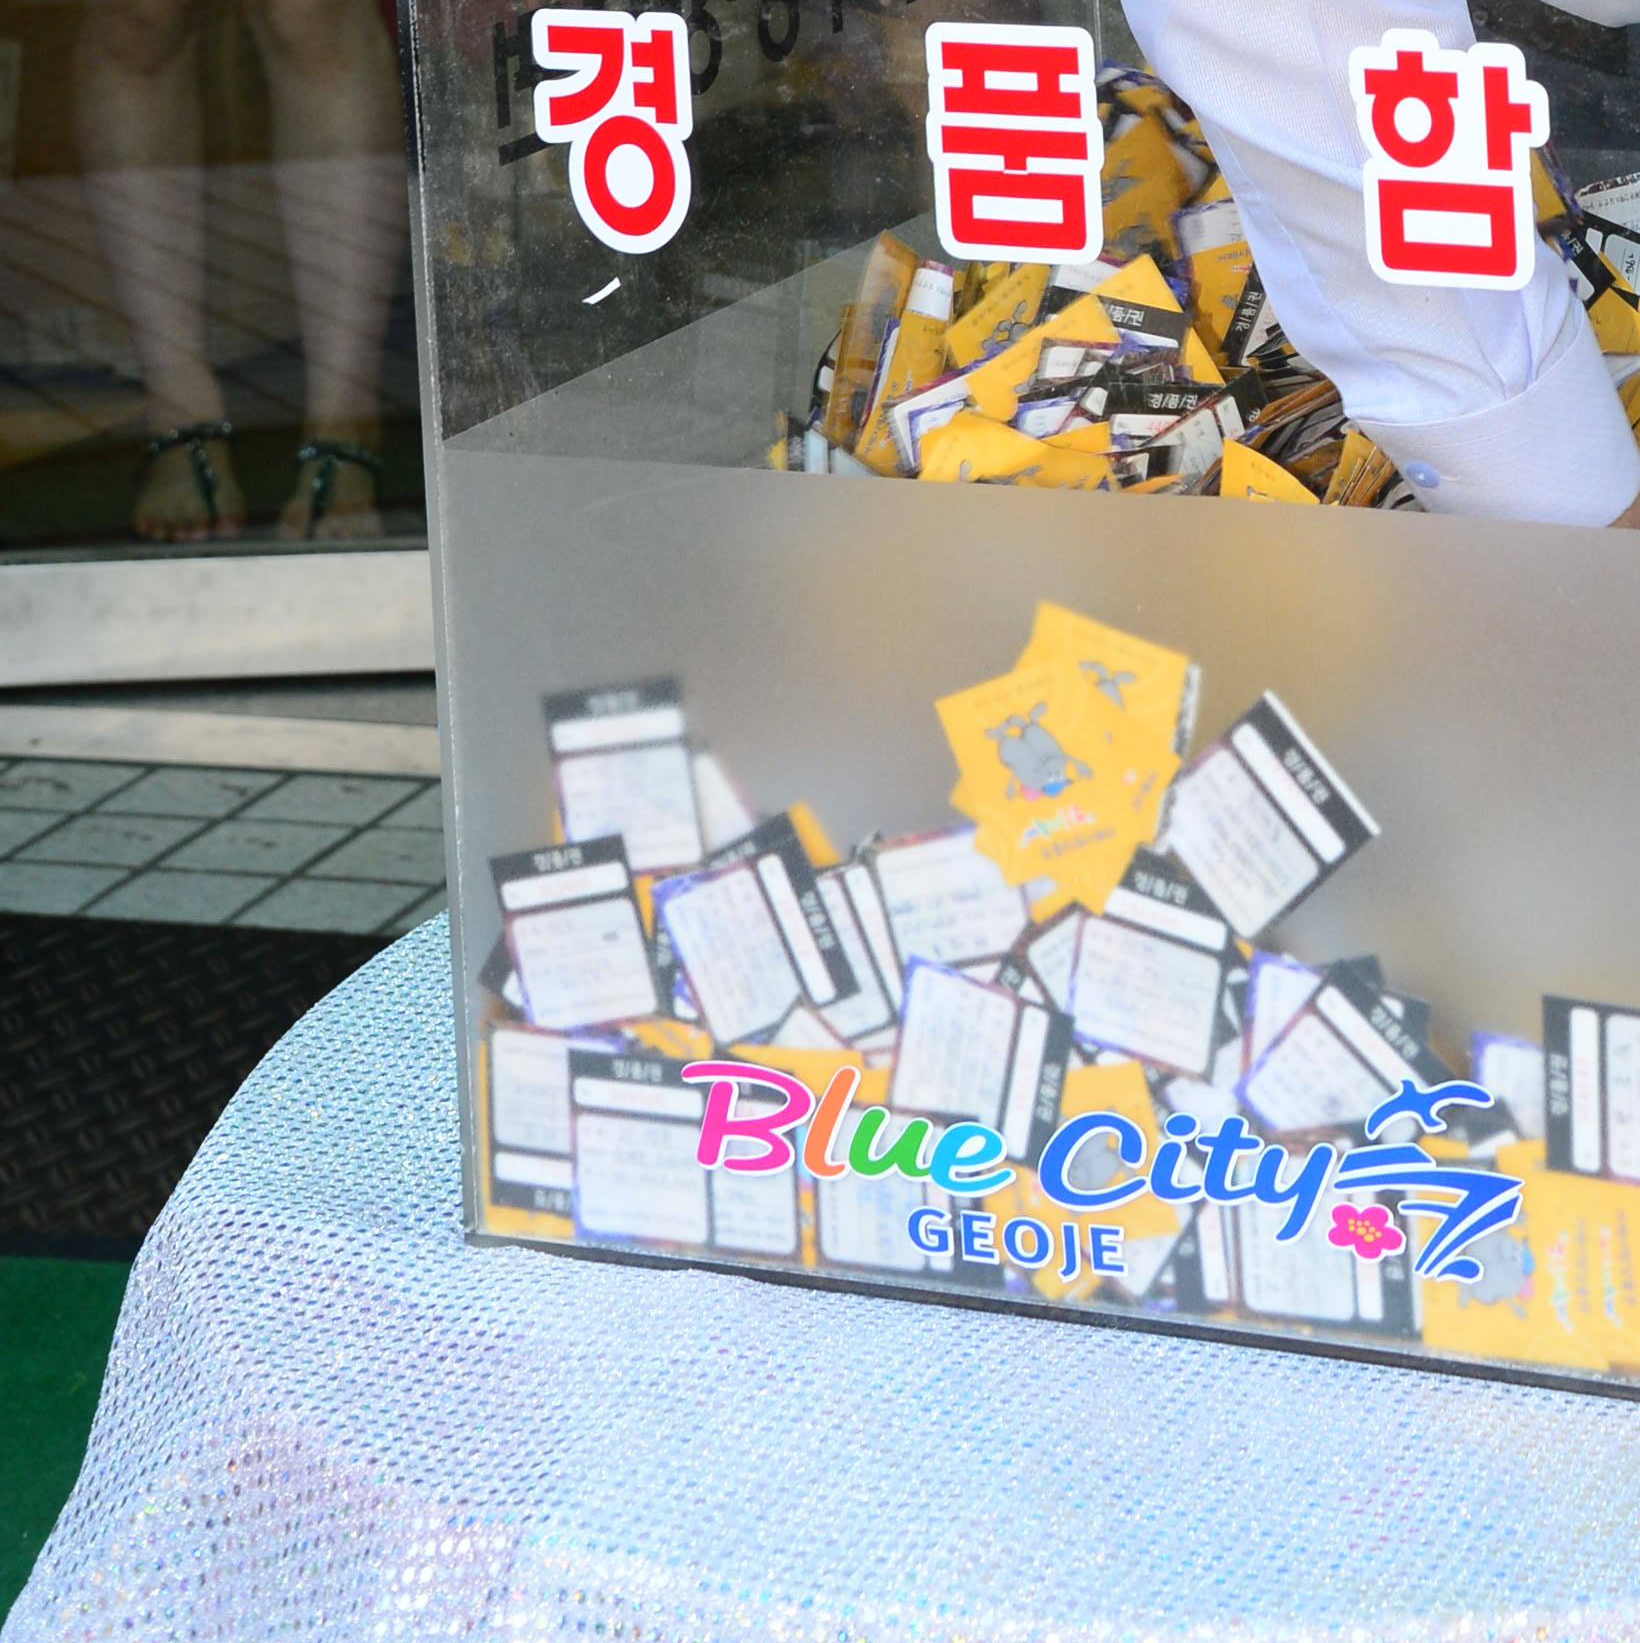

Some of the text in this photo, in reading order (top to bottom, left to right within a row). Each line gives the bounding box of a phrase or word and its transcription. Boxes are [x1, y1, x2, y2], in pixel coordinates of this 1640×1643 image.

[681, 1059, 1337, 1243] Blue City
[906, 1206, 1130, 1282] GEOJE
